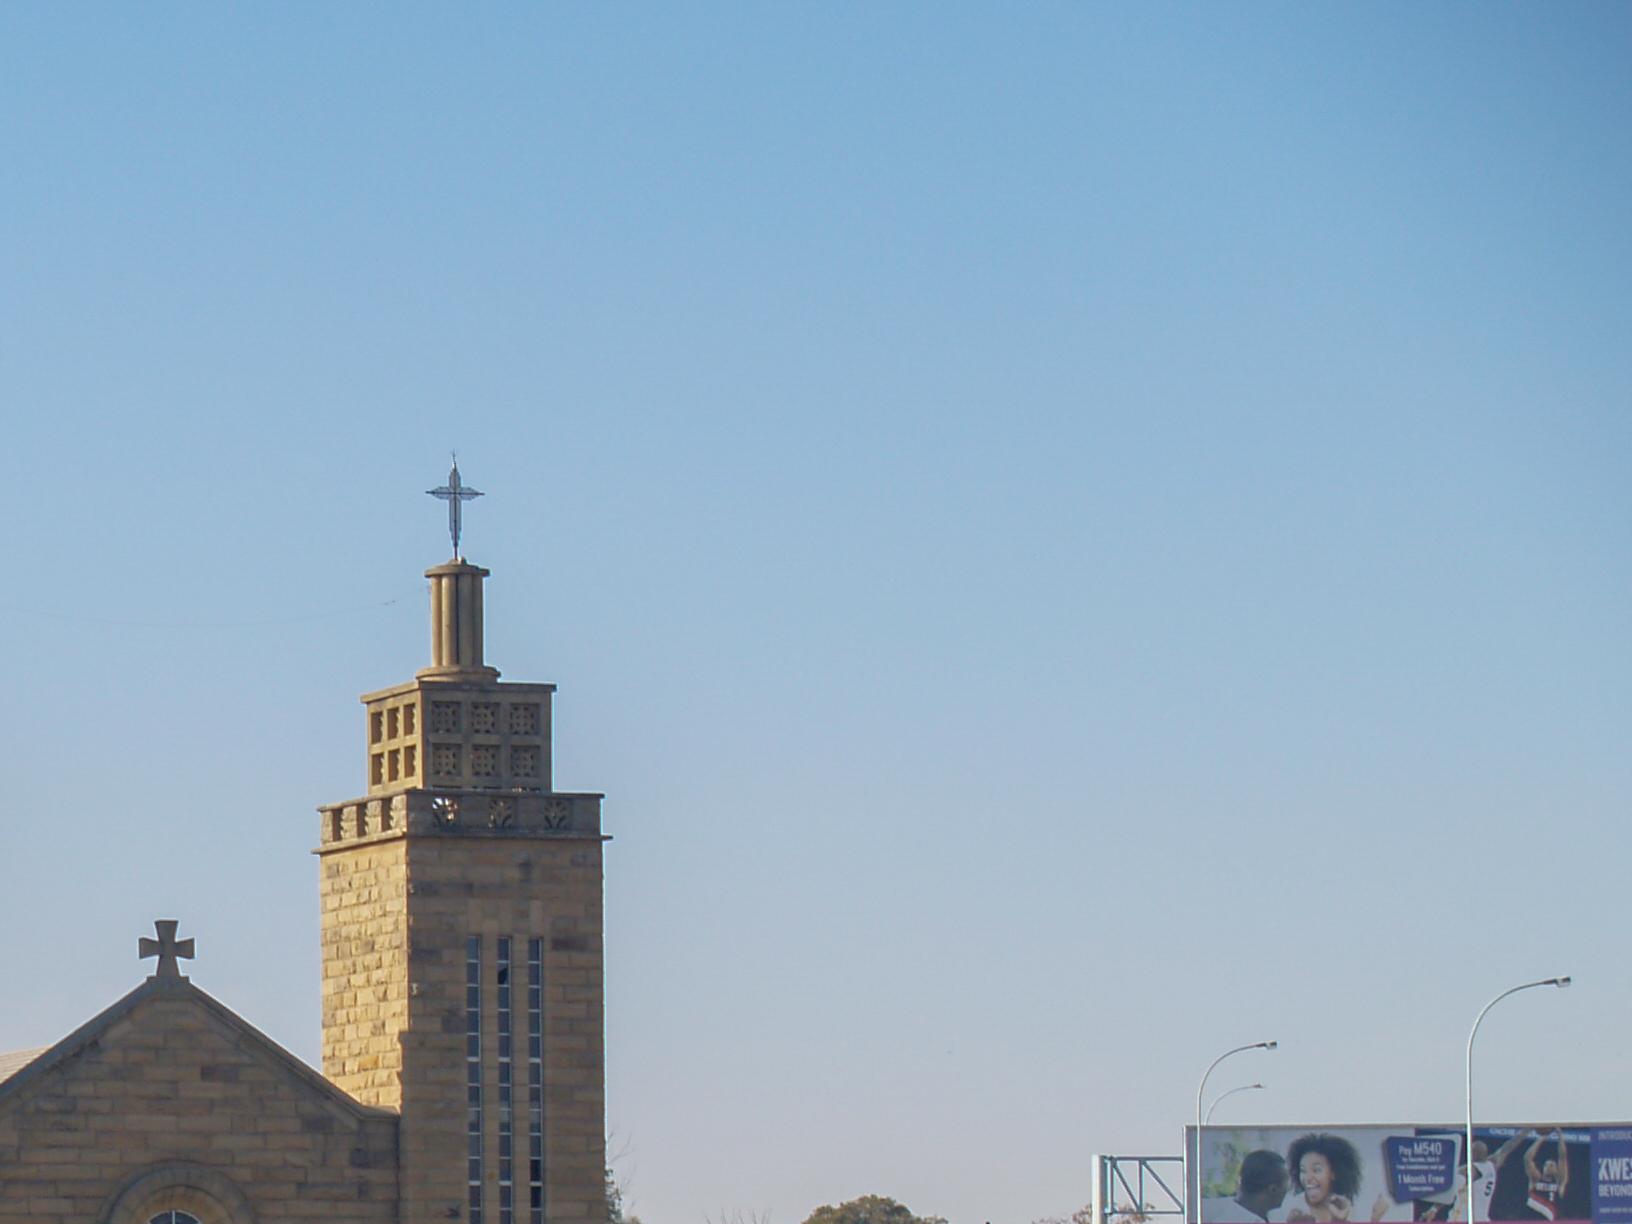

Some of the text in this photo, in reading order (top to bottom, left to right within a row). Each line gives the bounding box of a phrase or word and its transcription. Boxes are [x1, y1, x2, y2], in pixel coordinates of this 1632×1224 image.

[1399, 1142, 1442, 1158] Pay M540
[1403, 1174, 1426, 1185] Month
[1428, 1174, 1445, 1185] Free
